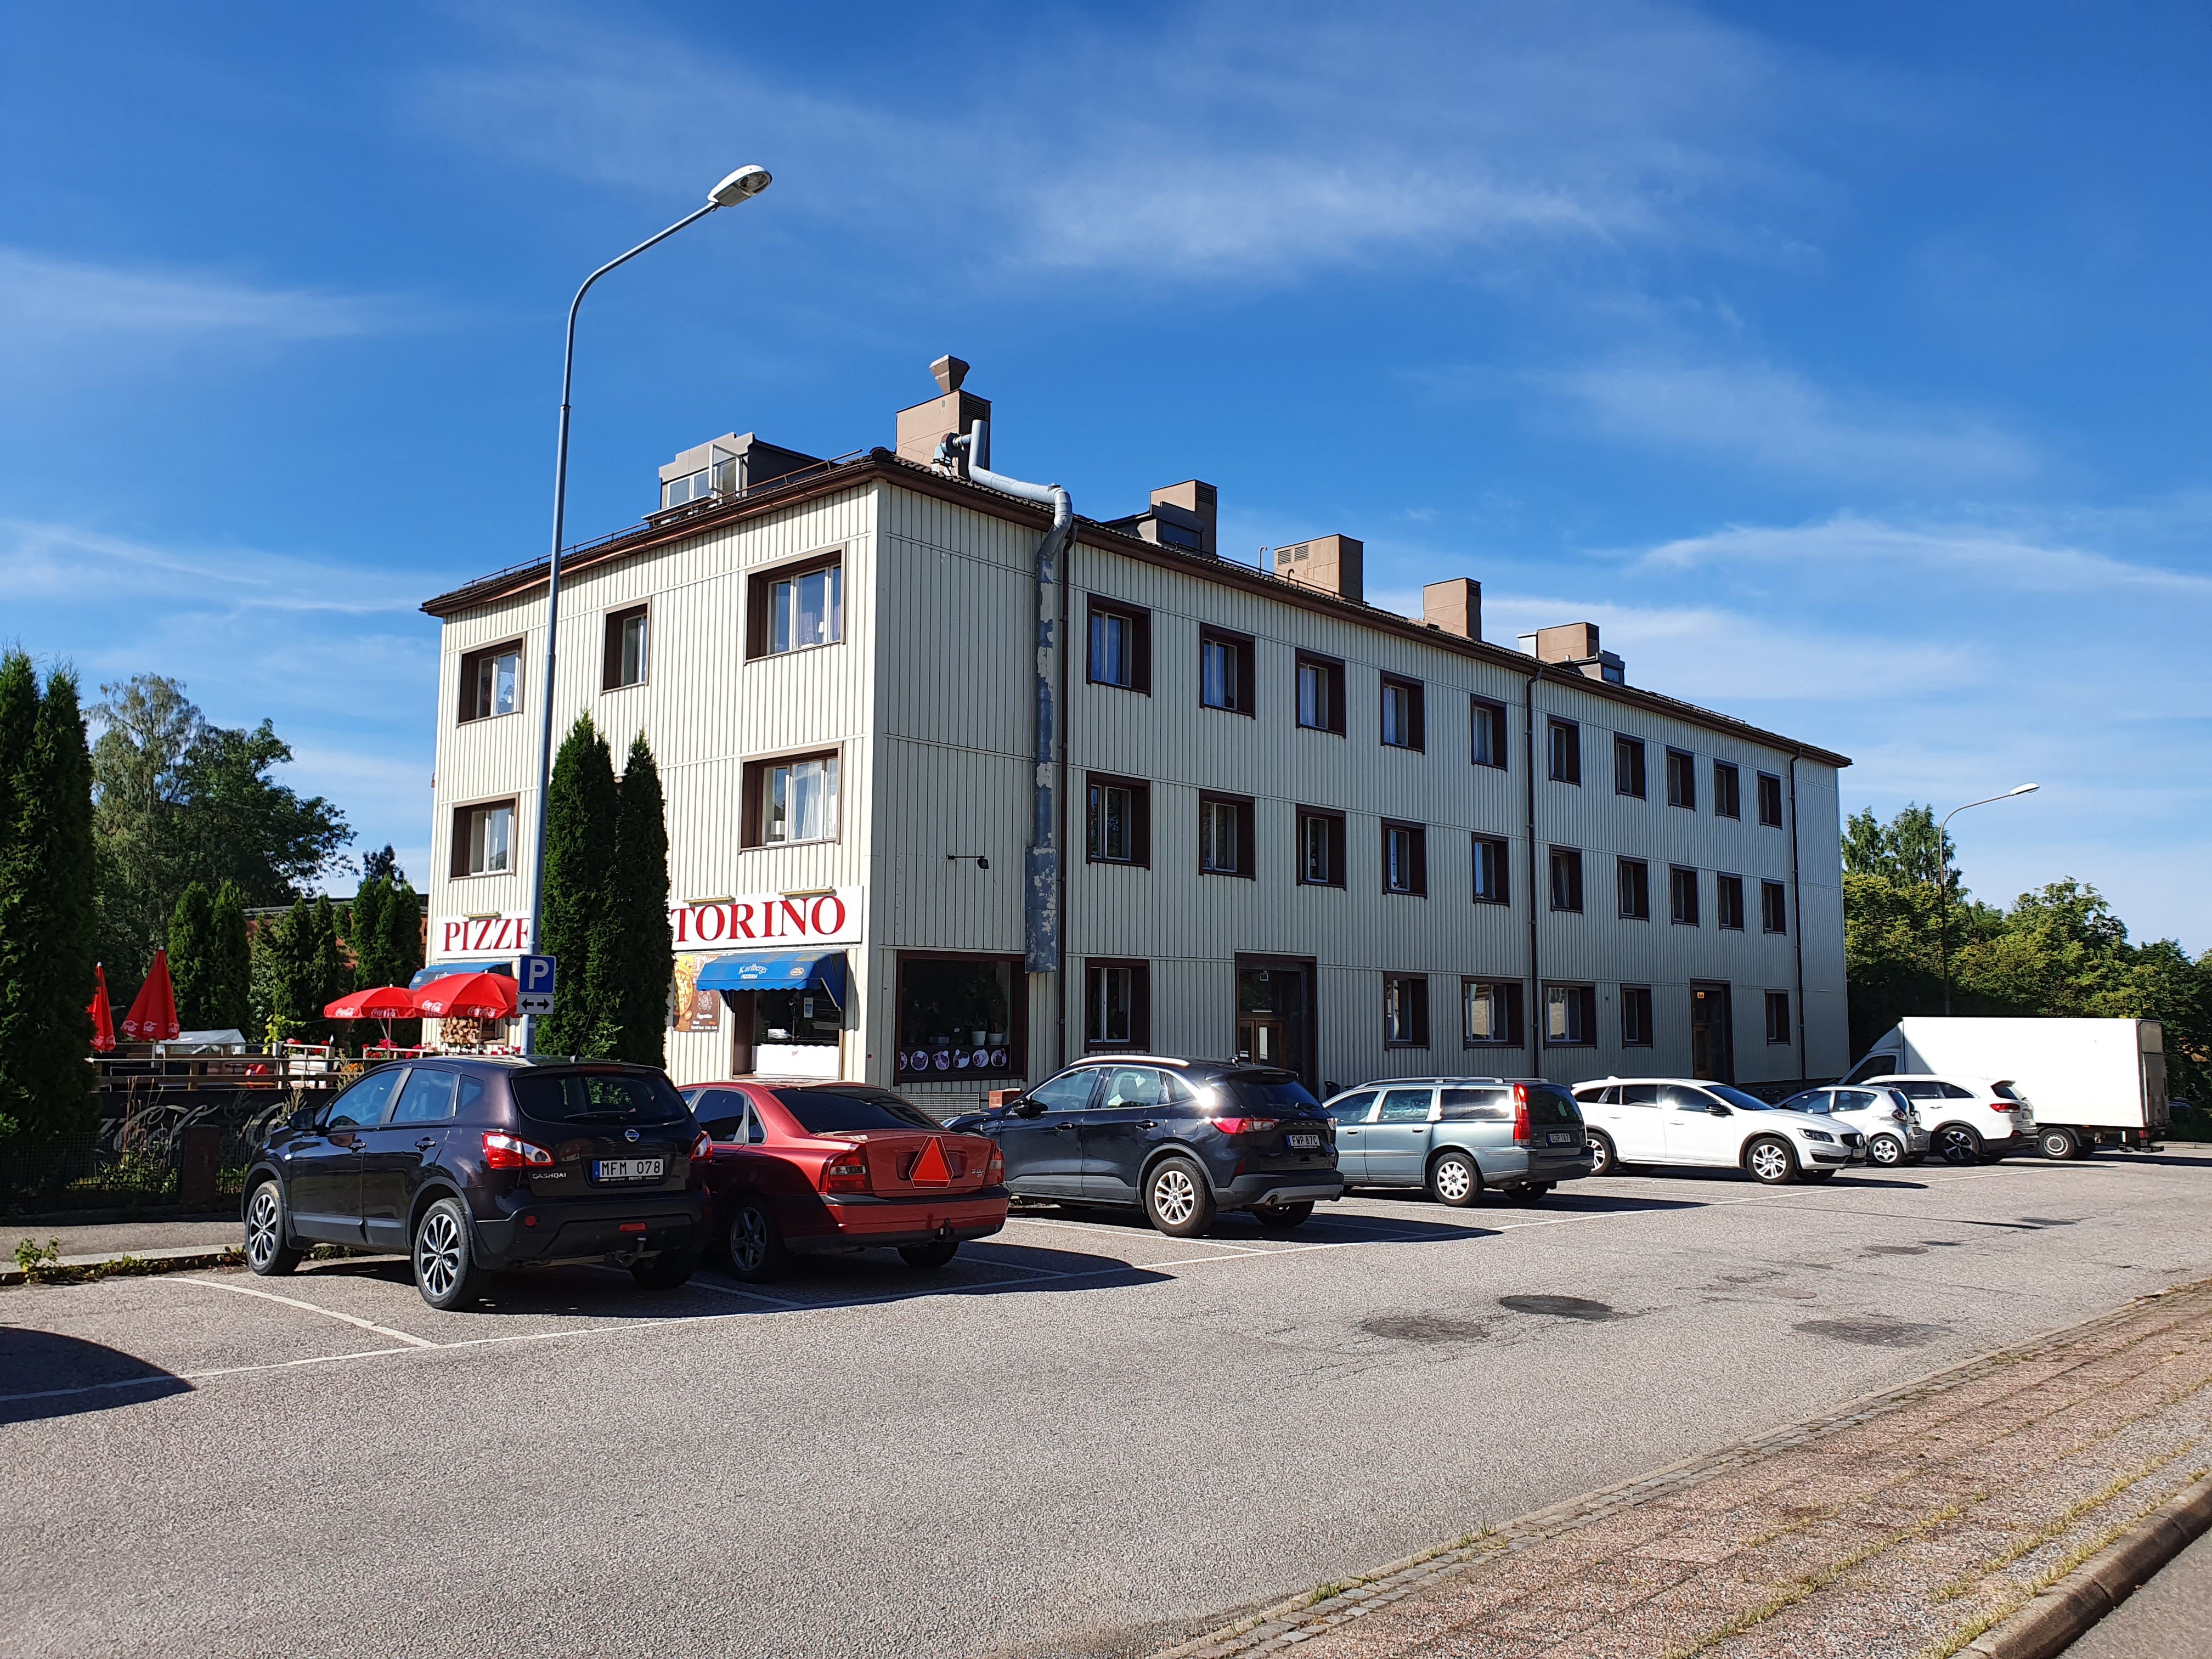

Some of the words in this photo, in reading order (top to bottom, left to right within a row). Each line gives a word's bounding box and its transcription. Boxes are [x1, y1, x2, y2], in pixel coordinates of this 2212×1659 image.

[442, 917, 531, 952] PIZZE
[671, 896, 845, 943] TORINO
[528, 959, 549, 989] P
[738, 963, 768, 974] Karlbergs
[1292, 1136, 1304, 1145] FWP
[1306, 1136, 1317, 1144] 87C
[602, 1162, 627, 1176] MFM
[637, 1161, 661, 1174] 078
